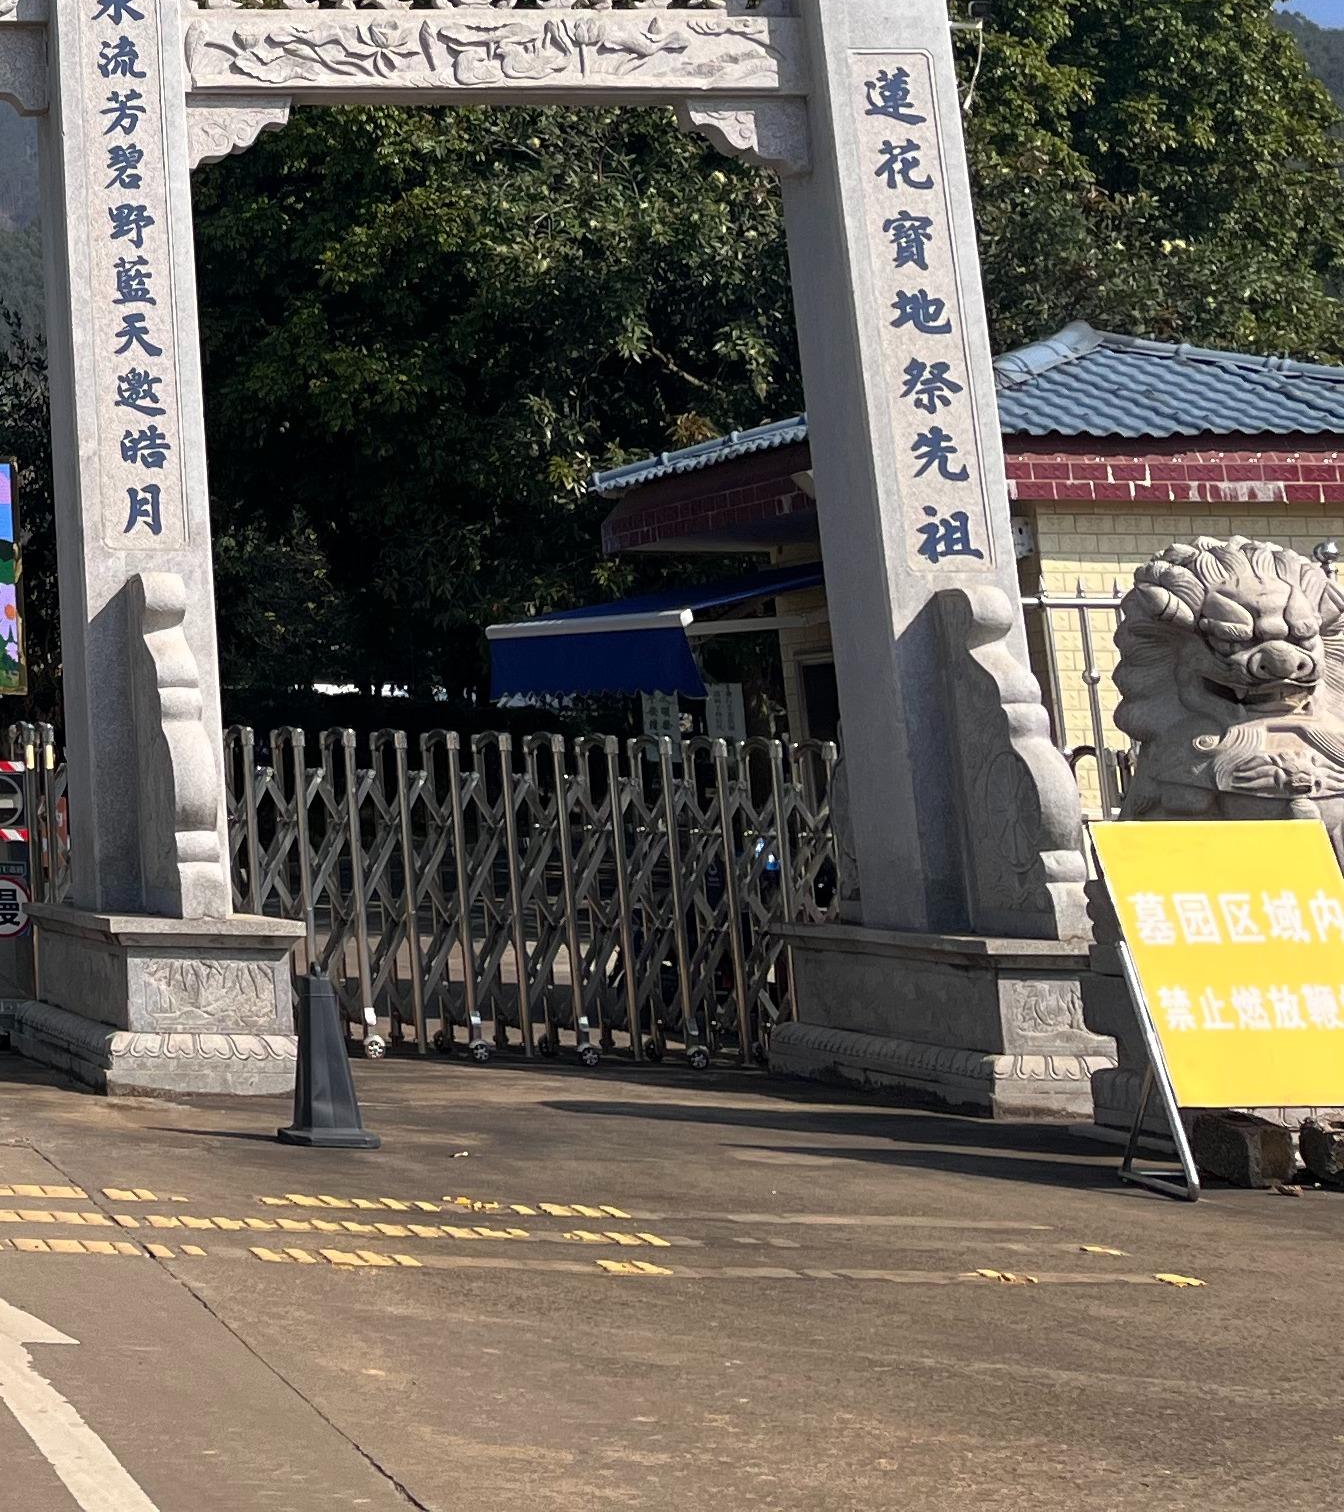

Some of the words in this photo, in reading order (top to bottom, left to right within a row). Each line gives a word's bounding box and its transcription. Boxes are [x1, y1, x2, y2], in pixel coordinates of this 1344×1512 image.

[863, 65, 985, 565] 蓮花寶地祭先祖
[1126, 889, 1344, 946] 墓园区域内
[1158, 985, 1344, 1032] 禁止燃放鞭
